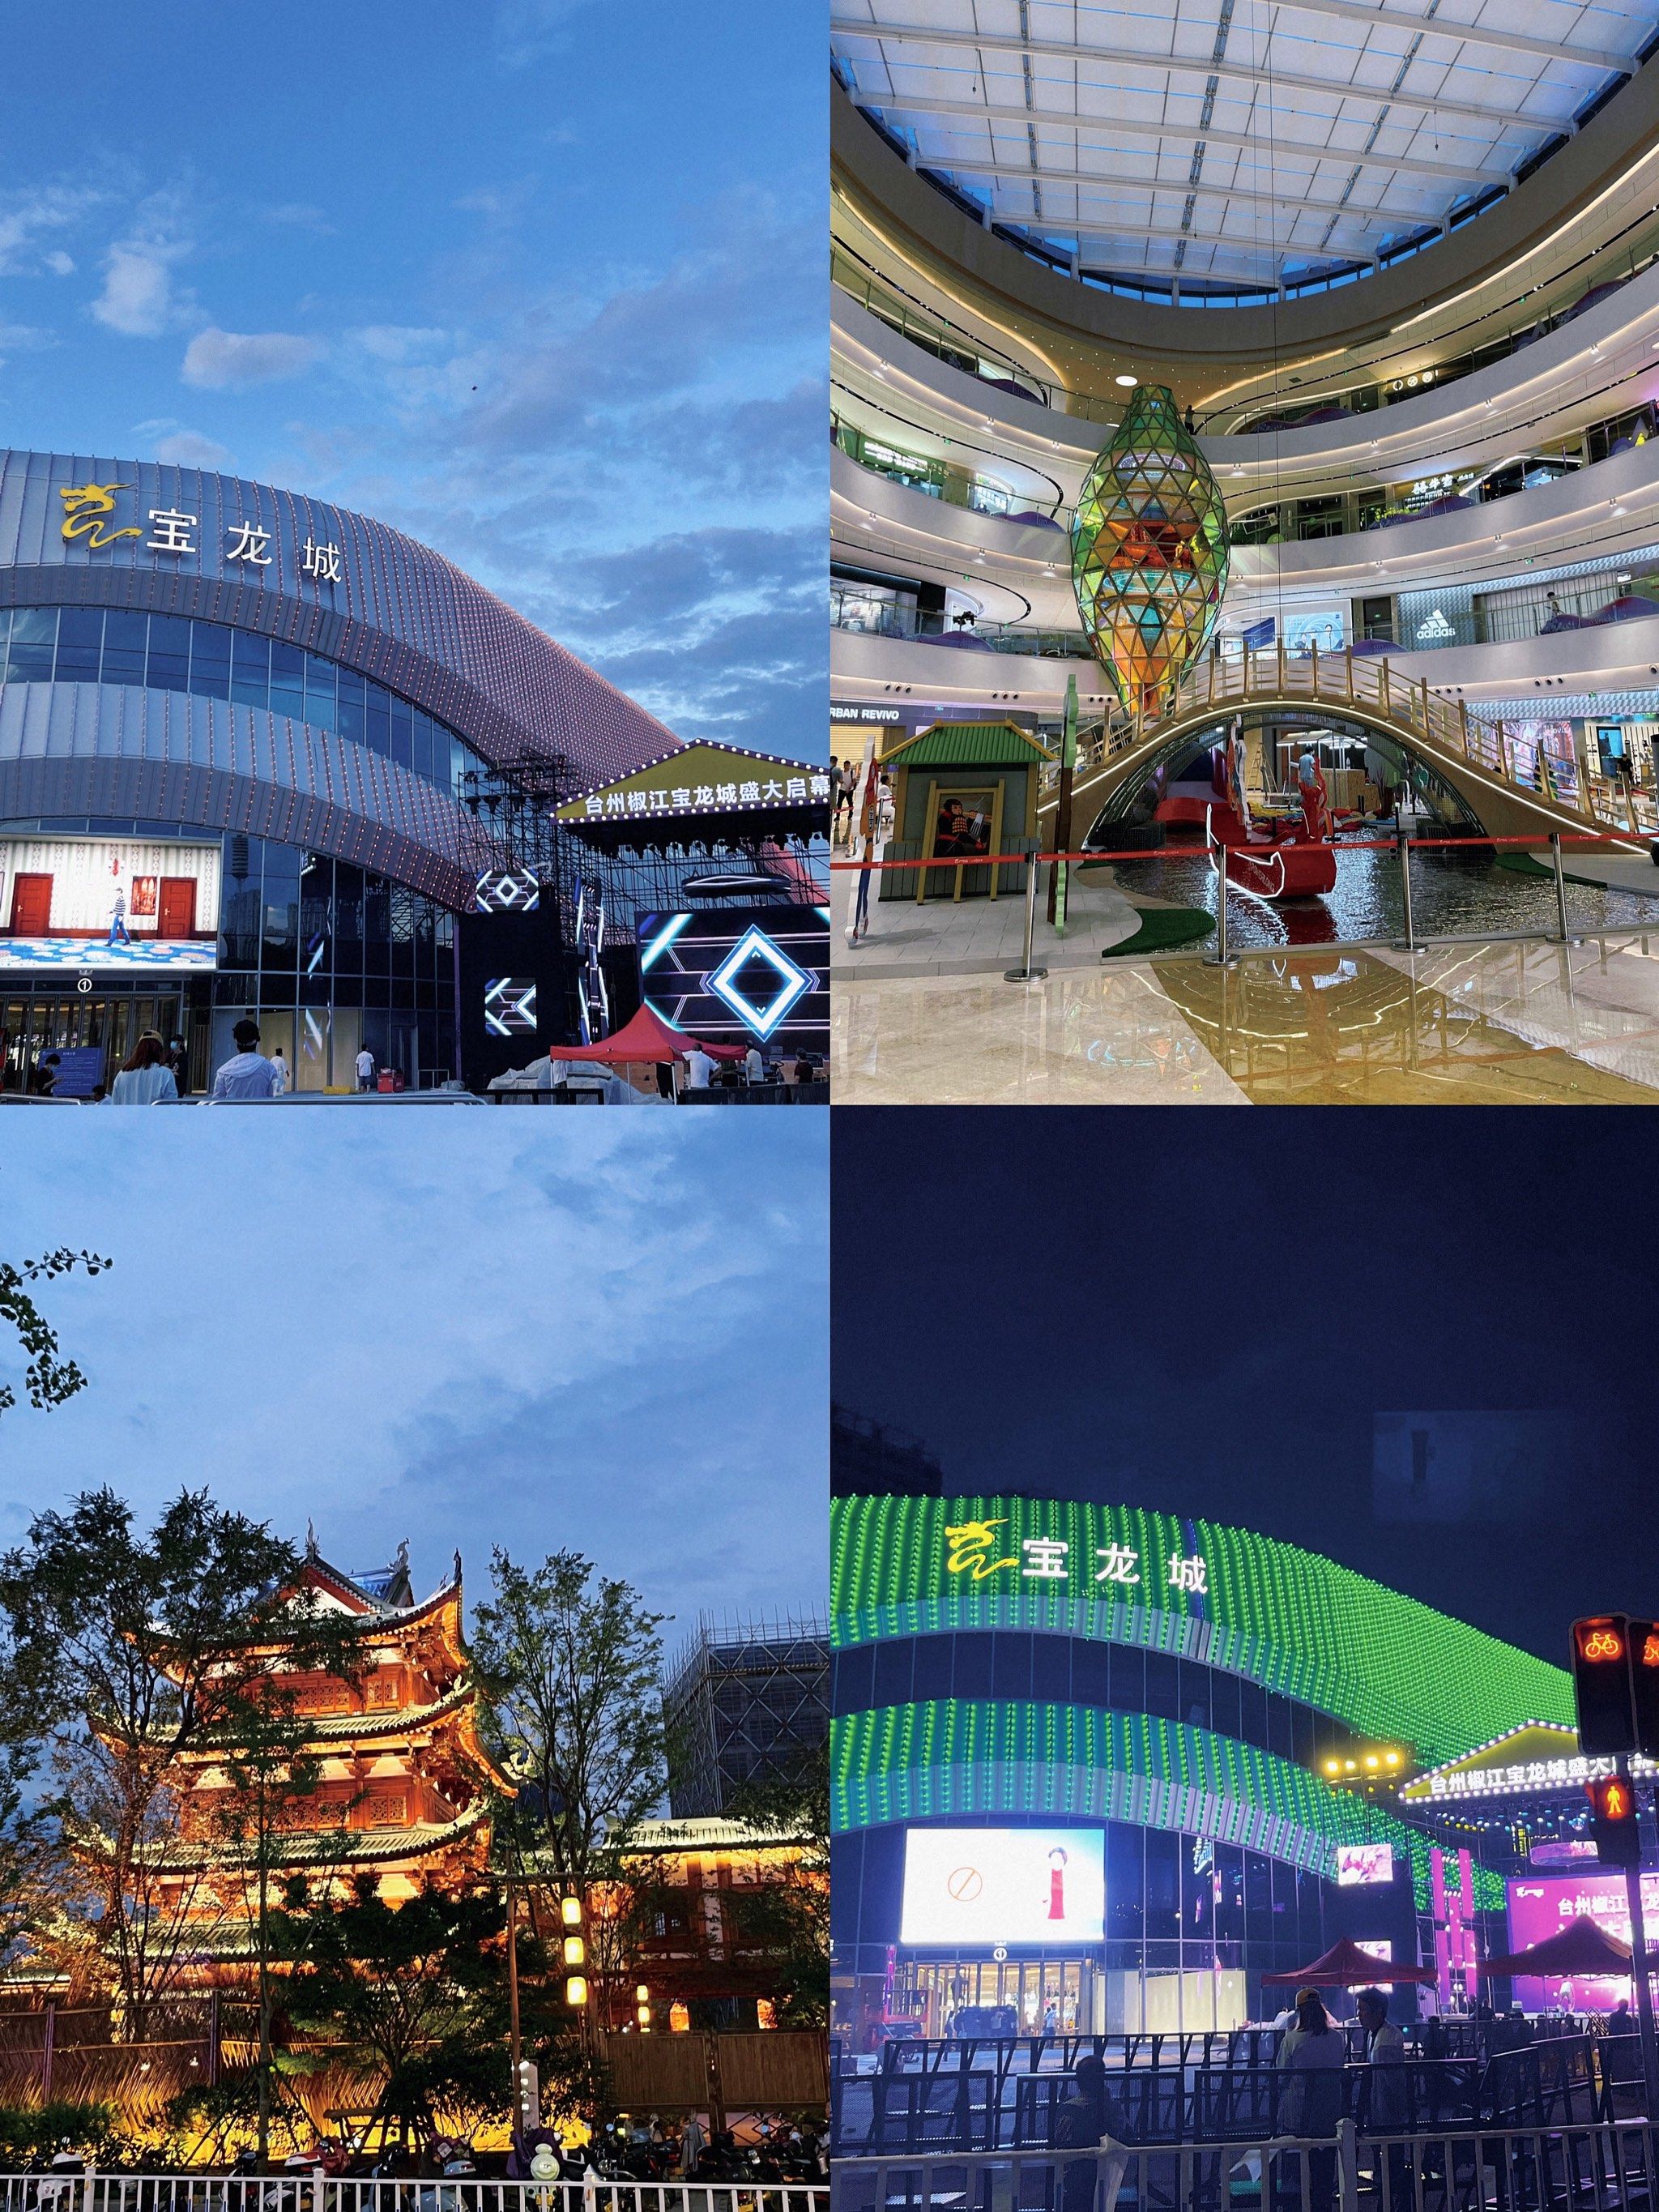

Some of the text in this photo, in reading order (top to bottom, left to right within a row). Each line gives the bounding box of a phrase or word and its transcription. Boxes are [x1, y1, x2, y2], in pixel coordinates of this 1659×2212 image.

[146, 507, 342, 583] 宝龙城
[1416, 627, 1456, 639] adidas
[861, 709, 900, 720] REVIVO
[584, 775, 830, 815] 台州椒江宝龙城盛大启幕
[1021, 1536, 1209, 1595] 宝龙城
